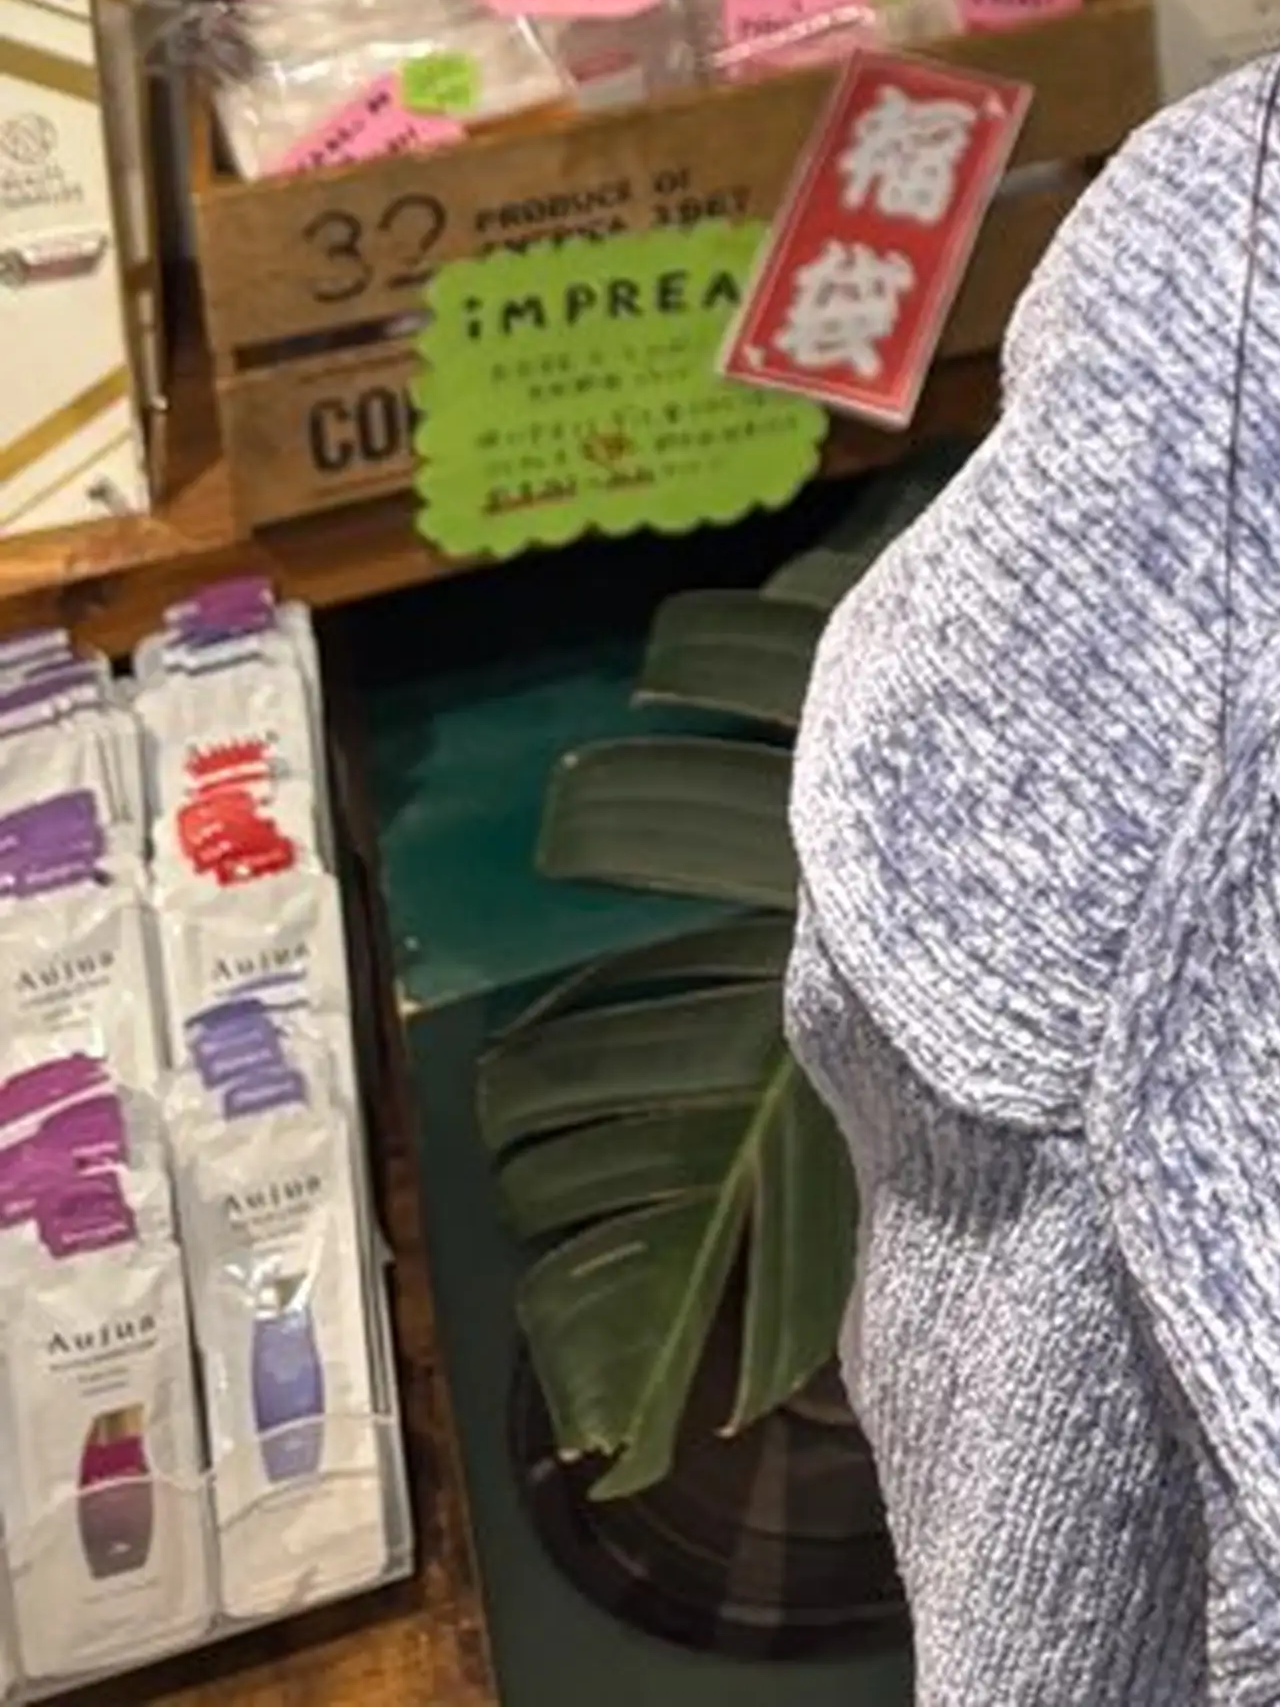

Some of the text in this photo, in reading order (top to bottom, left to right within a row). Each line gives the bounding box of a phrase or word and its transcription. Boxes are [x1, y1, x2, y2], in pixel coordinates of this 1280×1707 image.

[302, 191, 447, 304] 32
[309, 384, 428, 473] CO
[47, 1312, 157, 1356] Aujua
